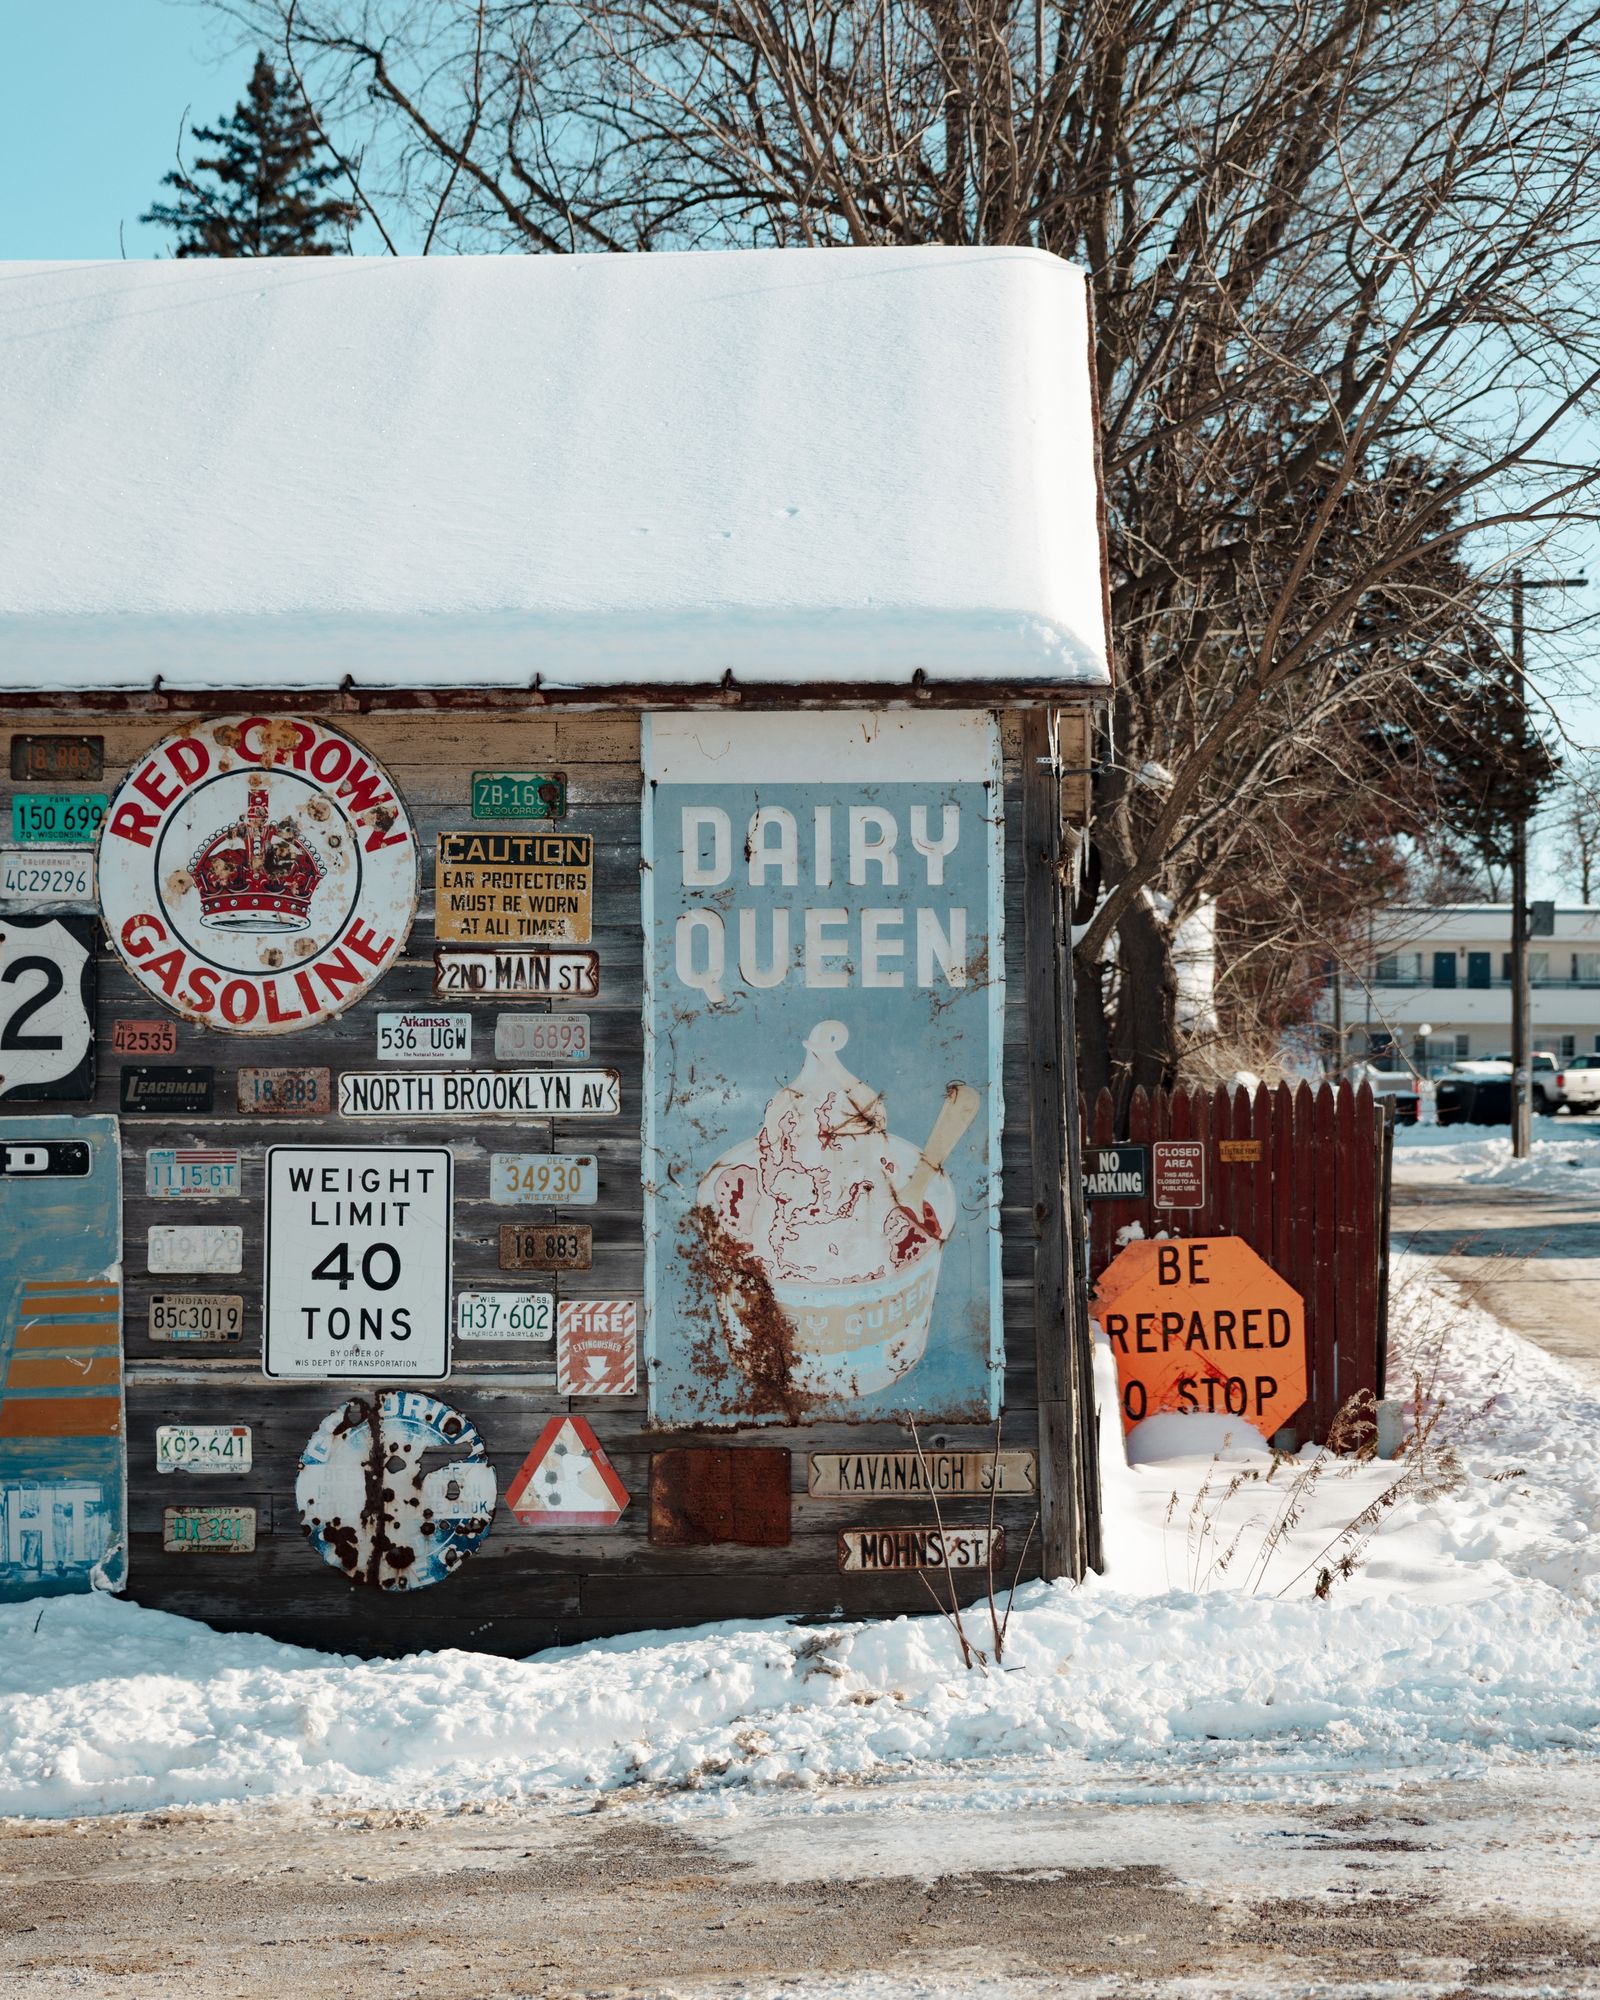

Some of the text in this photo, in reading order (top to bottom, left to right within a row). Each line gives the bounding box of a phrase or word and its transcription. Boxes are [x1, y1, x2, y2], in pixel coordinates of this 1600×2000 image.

[109, 717, 408, 854] RED CROWN
[19, 805, 104, 831] 150 699
[494, 807, 546, 815] COLORADO
[37, 831, 83, 839] WISCONSIN
[681, 805, 960, 887] DAIRY
[22, 858, 71, 866] CALIFORNIA
[443, 837, 588, 863] CAUTION
[5, 869, 87, 893] 4C29296
[443, 872, 587, 890] EAR PROTECTORS
[450, 894, 578, 913] MUST BE WORN
[460, 918, 566, 936] AT ALL TIMES
[675, 907, 967, 1003] QUEEN
[121, 913, 395, 1025] GASOLINE
[447, 956, 585, 990] 2ND MAIN ST
[1, 955, 64, 1051] 2
[399, 1016, 451, 1027] Arkansas
[115, 1032, 174, 1051] 42535
[381, 1028, 466, 1049] 536 UGW
[533, 1024, 586, 1050] 6893
[126, 1076, 208, 1102] LEACHMAN
[352, 1076, 603, 1111] NORTH BROOKLYN AV
[1099, 1151, 1120, 1172] NO
[1157, 1147, 1200, 1157] CLOSED
[1164, 1159, 1193, 1168] AREA
[288, 1168, 435, 1193] WEIGHT
[506, 1165, 581, 1193] 34930
[311, 1202, 411, 1226] LIMIT
[516, 1234, 578, 1259] 18 883
[311, 1242, 401, 1291] 40
[1157, 1243, 1210, 1286] BE
[174, 1297, 219, 1305] INDIANA
[479, 1296, 496, 1304] WIS
[154, 1306, 238, 1330] 85C3019
[301, 1307, 412, 1341] TONS
[570, 1313, 624, 1333] FIRE
[1106, 1308, 1291, 1354] REPARED
[329, 1349, 385, 1357] BY ORDER OF
[572, 1340, 622, 1353] EXTINGUISHER
[294, 1359, 417, 1368] WIS DEPT OF TRANSPORTATION
[1177, 1375, 1279, 1417] STOP
[839, 1456, 1006, 1491] KAVANAUGH ST
[860, 1532, 984, 1568] MOHNS ST
